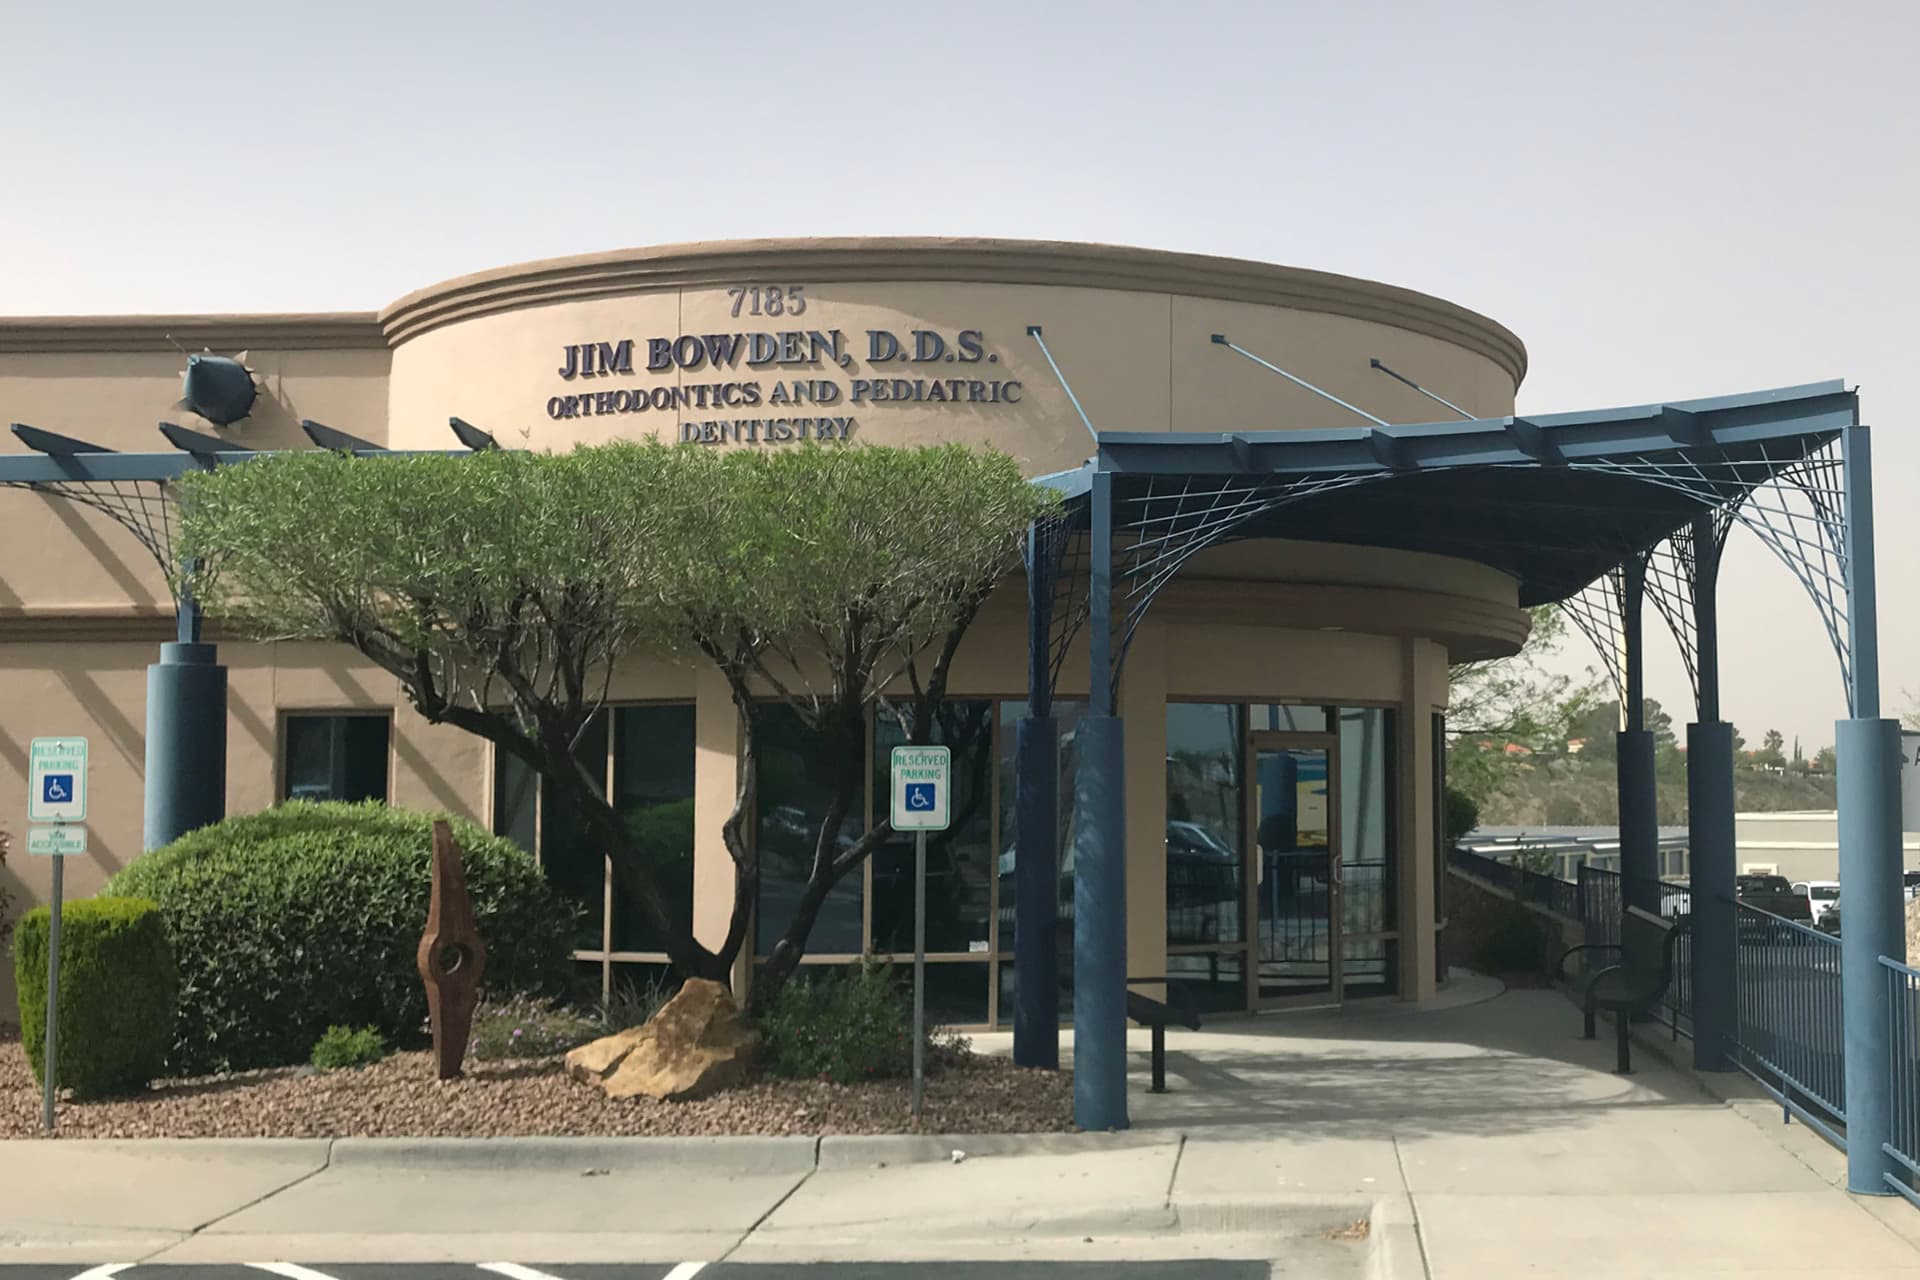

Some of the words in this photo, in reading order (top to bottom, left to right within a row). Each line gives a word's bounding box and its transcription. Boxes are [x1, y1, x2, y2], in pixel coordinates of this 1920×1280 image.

[727, 286, 806, 317] 7185
[559, 339, 635, 379] JIM
[646, 330, 852, 371] BOWDEN,
[866, 329, 998, 363] D.D.S.
[547, 381, 763, 419] ORTHODONTICS
[768, 380, 840, 403] AND
[849, 379, 1022, 403] PEDIATRIC
[680, 417, 854, 444] DENTISTRY
[895, 755, 946, 766] RESERVED
[901, 769, 942, 780] PARKING
